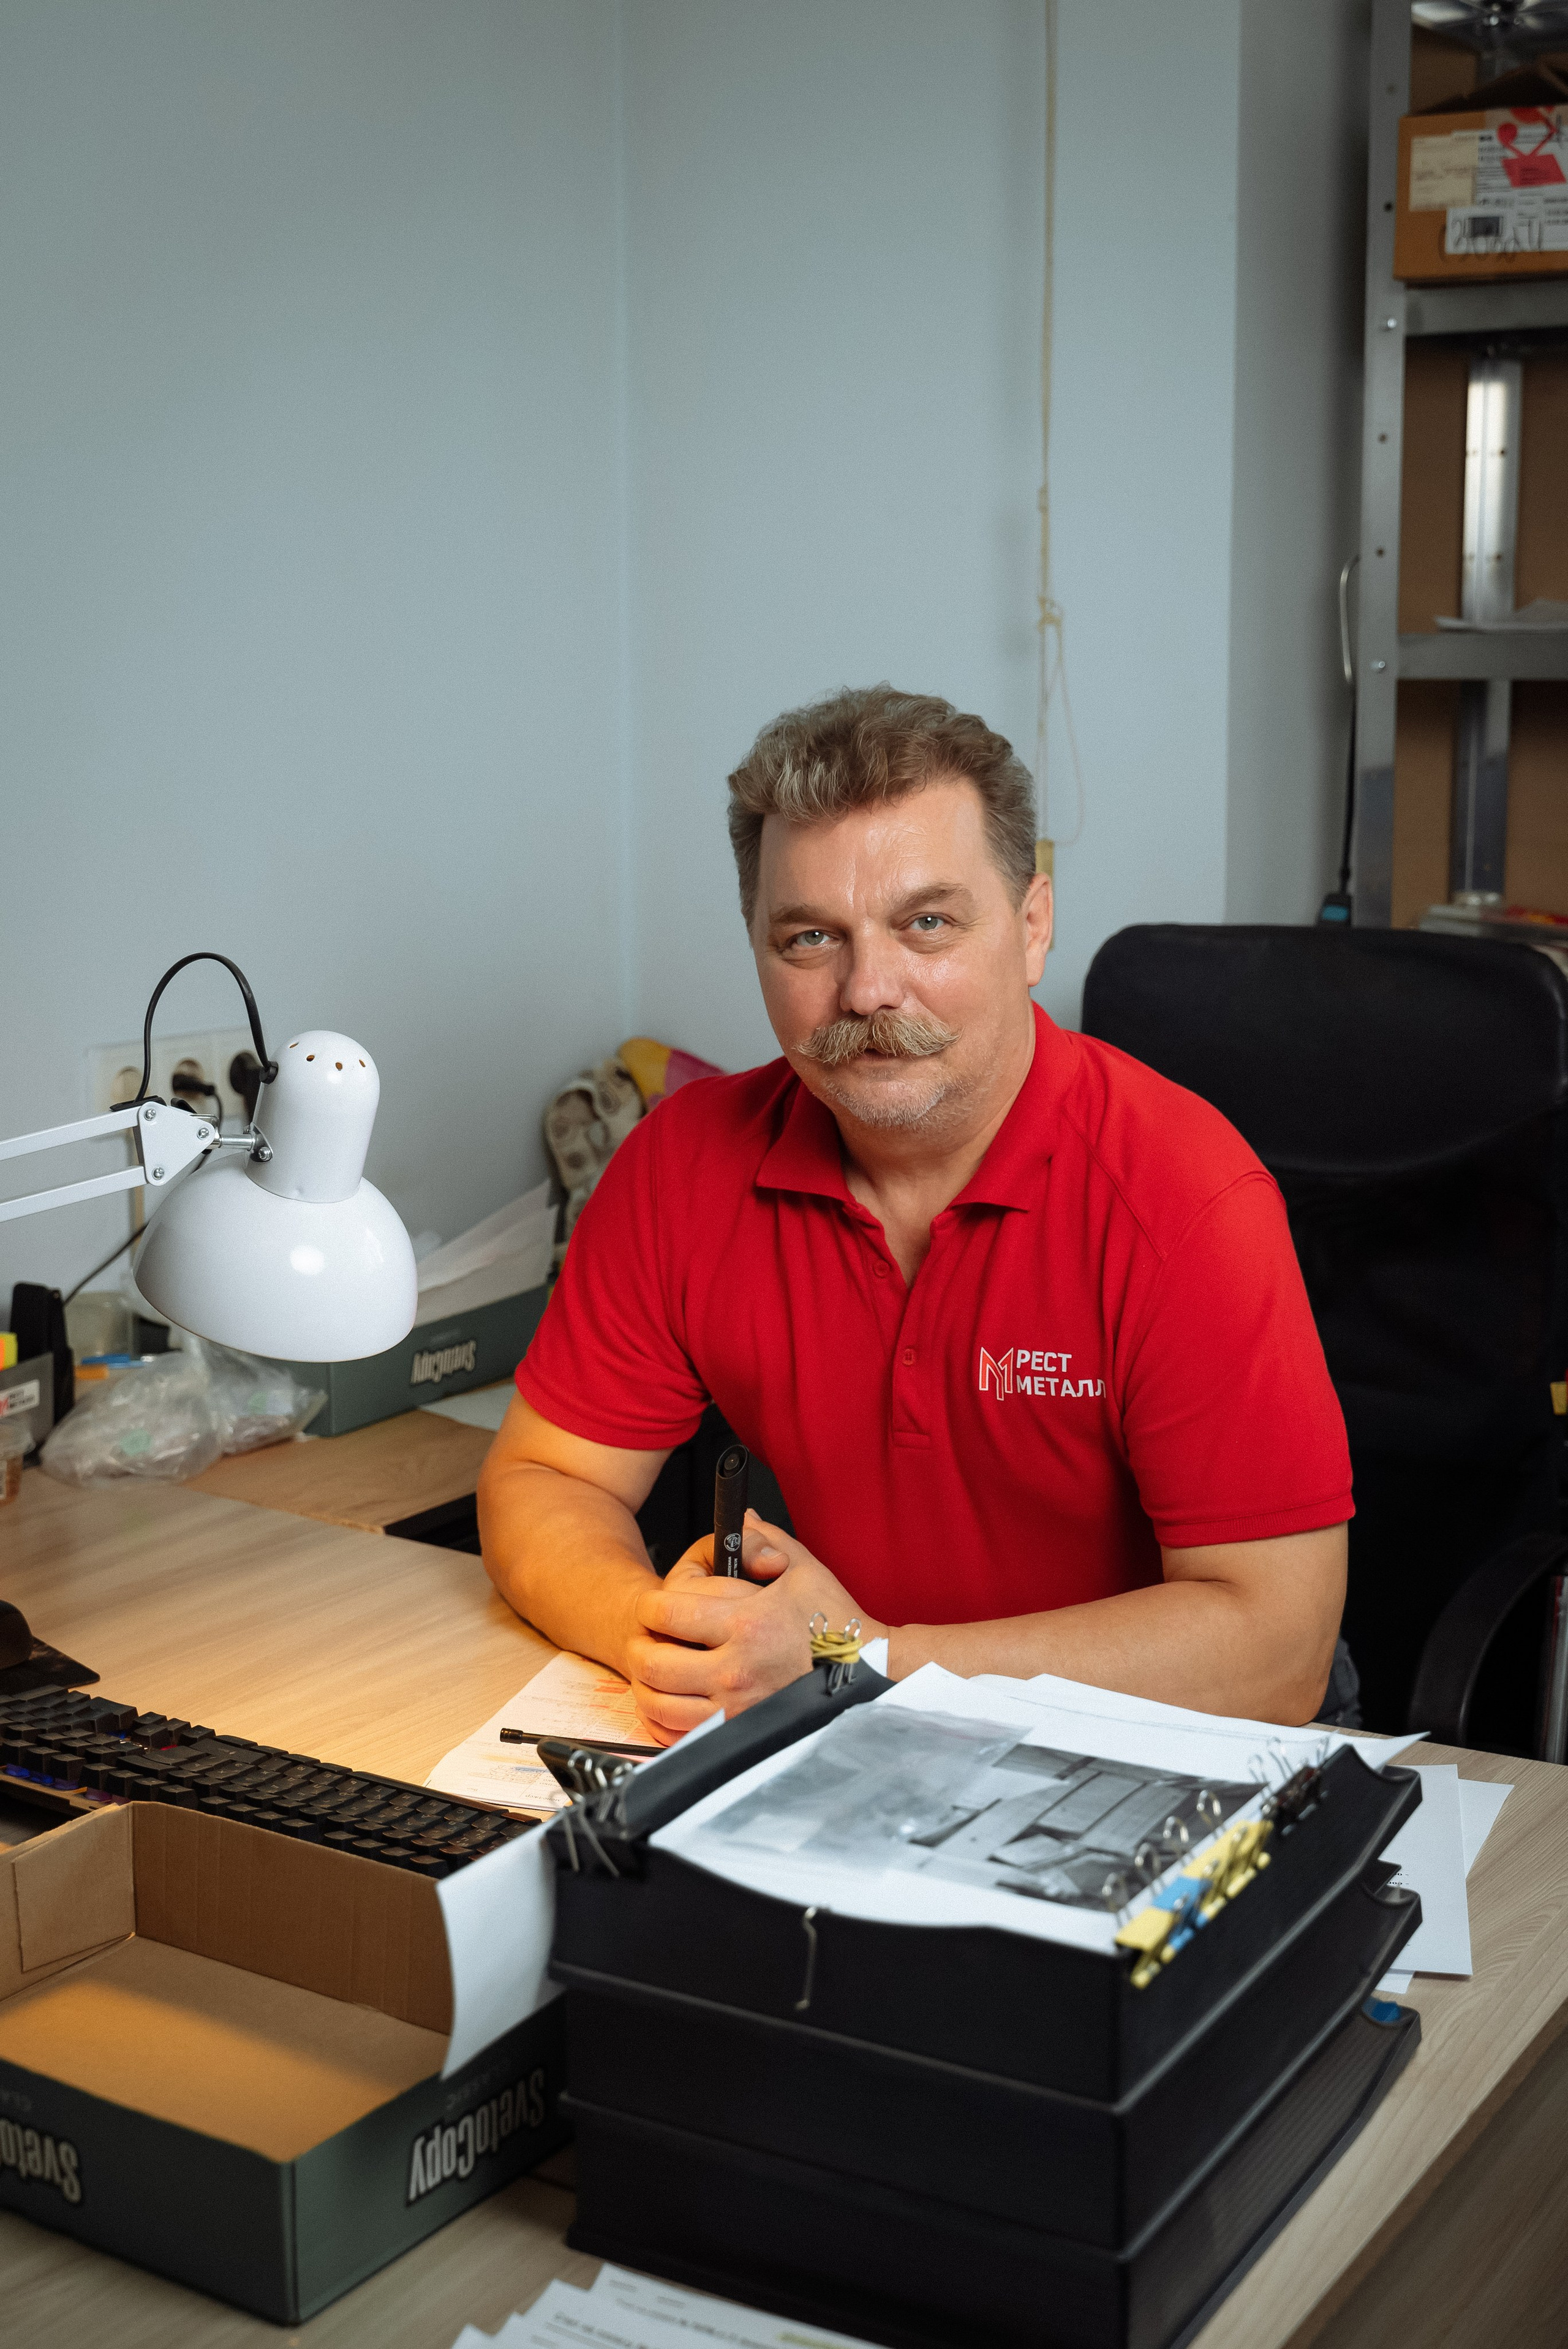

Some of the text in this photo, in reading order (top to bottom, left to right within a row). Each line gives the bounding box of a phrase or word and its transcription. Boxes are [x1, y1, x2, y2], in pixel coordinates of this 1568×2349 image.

[1016, 1349, 1072, 1372] РЕСТ
[1016, 1374, 1106, 1398] МЕТАЛЛ
[408, 2068, 545, 2202] SvetoCopy
